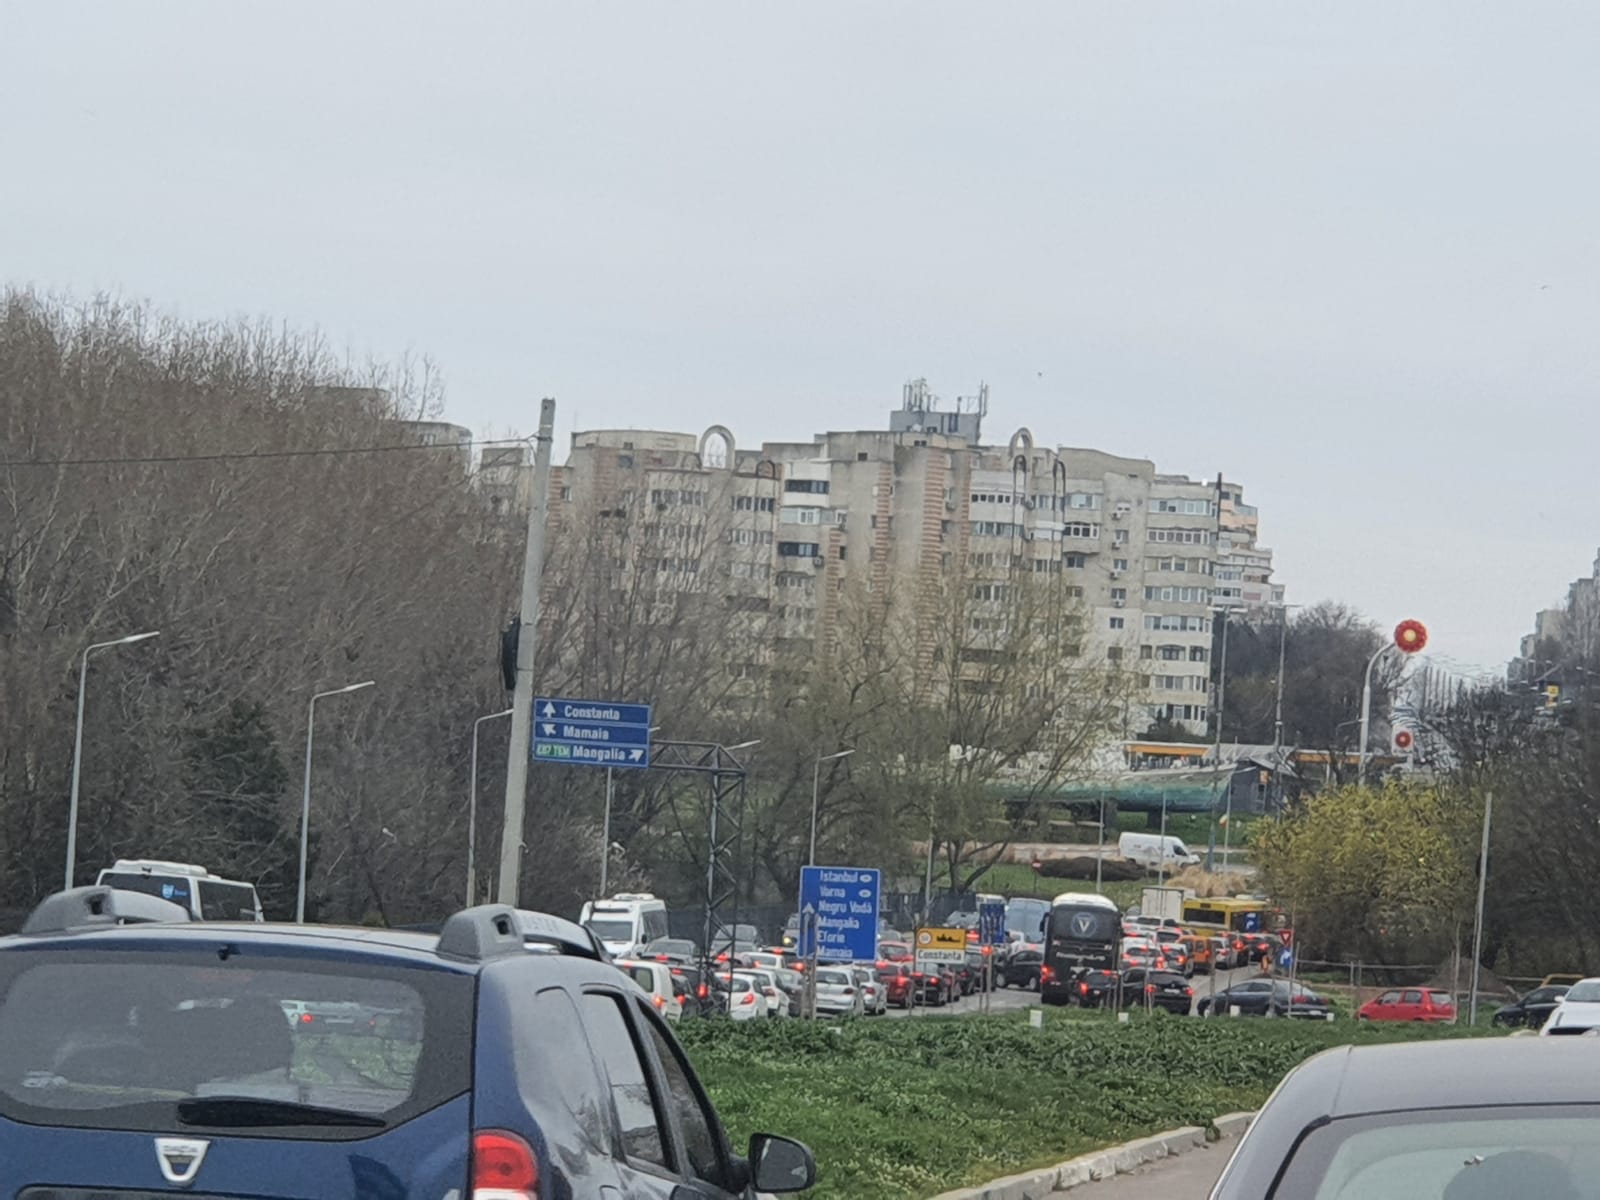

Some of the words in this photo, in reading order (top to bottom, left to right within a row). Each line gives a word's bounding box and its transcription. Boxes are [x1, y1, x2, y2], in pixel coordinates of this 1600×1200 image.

[563, 725, 609, 739] Mamaia
[573, 746, 625, 761] Mangalia
[820, 870, 858, 882] Istanbul
[819, 885, 845, 897] Varna
[818, 900, 846, 915] Negru
[817, 916, 859, 930] Mangalia
[817, 931, 845, 943] Eforie
[817, 946, 853, 958] Mamaia
